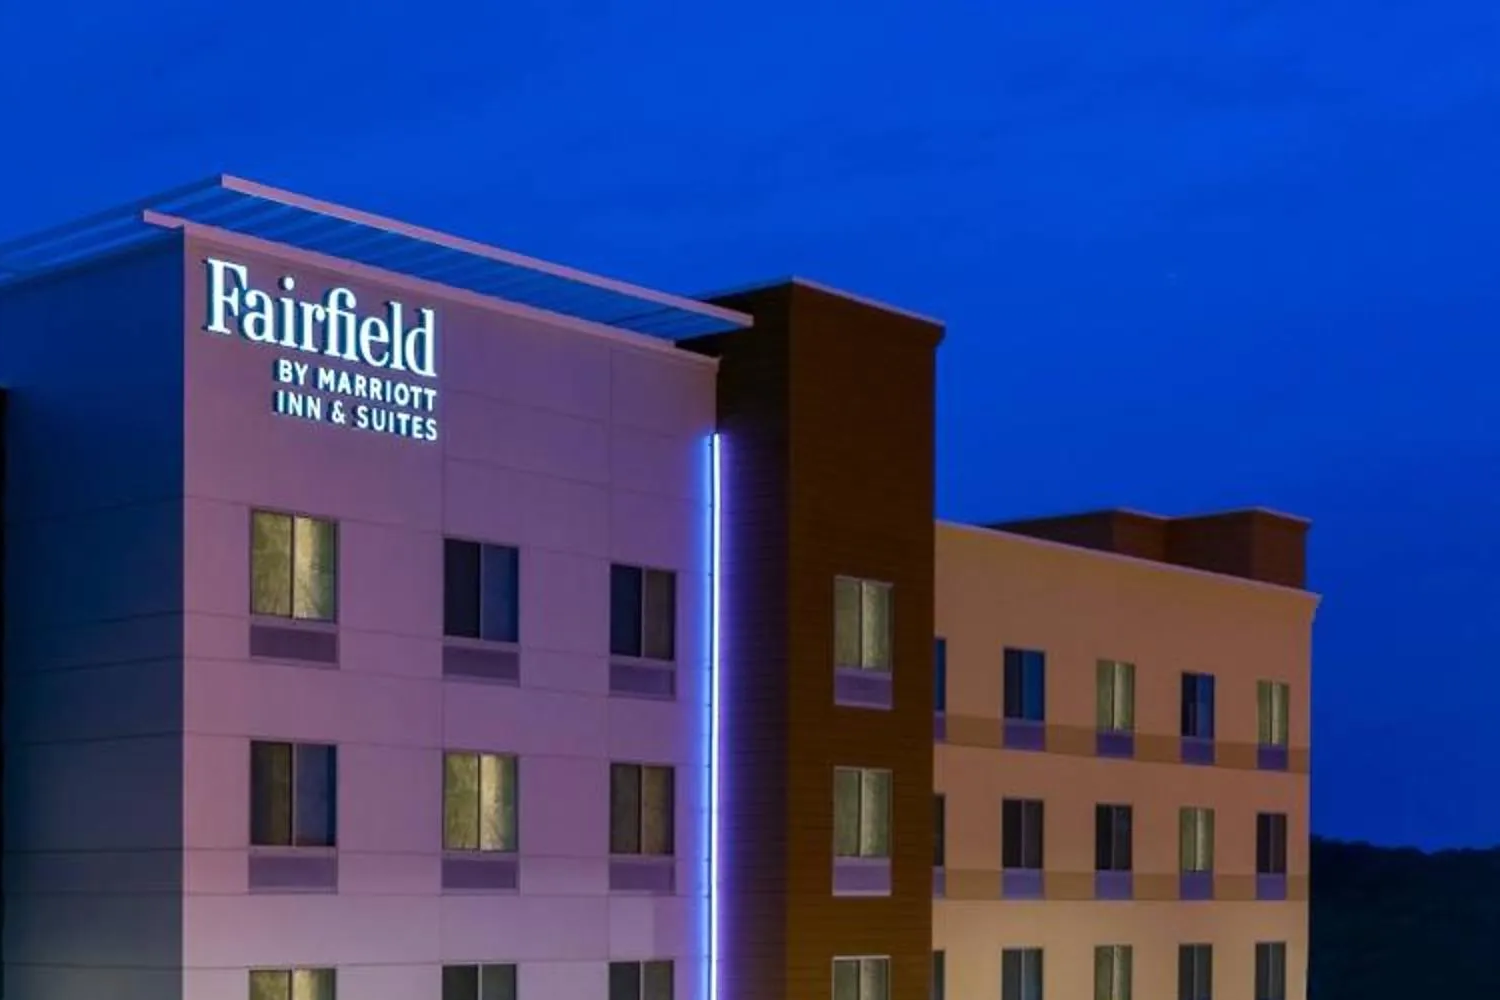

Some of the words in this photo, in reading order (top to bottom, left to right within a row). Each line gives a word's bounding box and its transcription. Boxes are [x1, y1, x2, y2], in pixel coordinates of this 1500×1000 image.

[205, 257, 437, 377] Fairfield
[277, 359, 308, 386] BY
[317, 367, 437, 411] MARRIOTT
[276, 390, 321, 420] INN
[330, 400, 346, 424] &
[356, 405, 438, 441] SUITES
